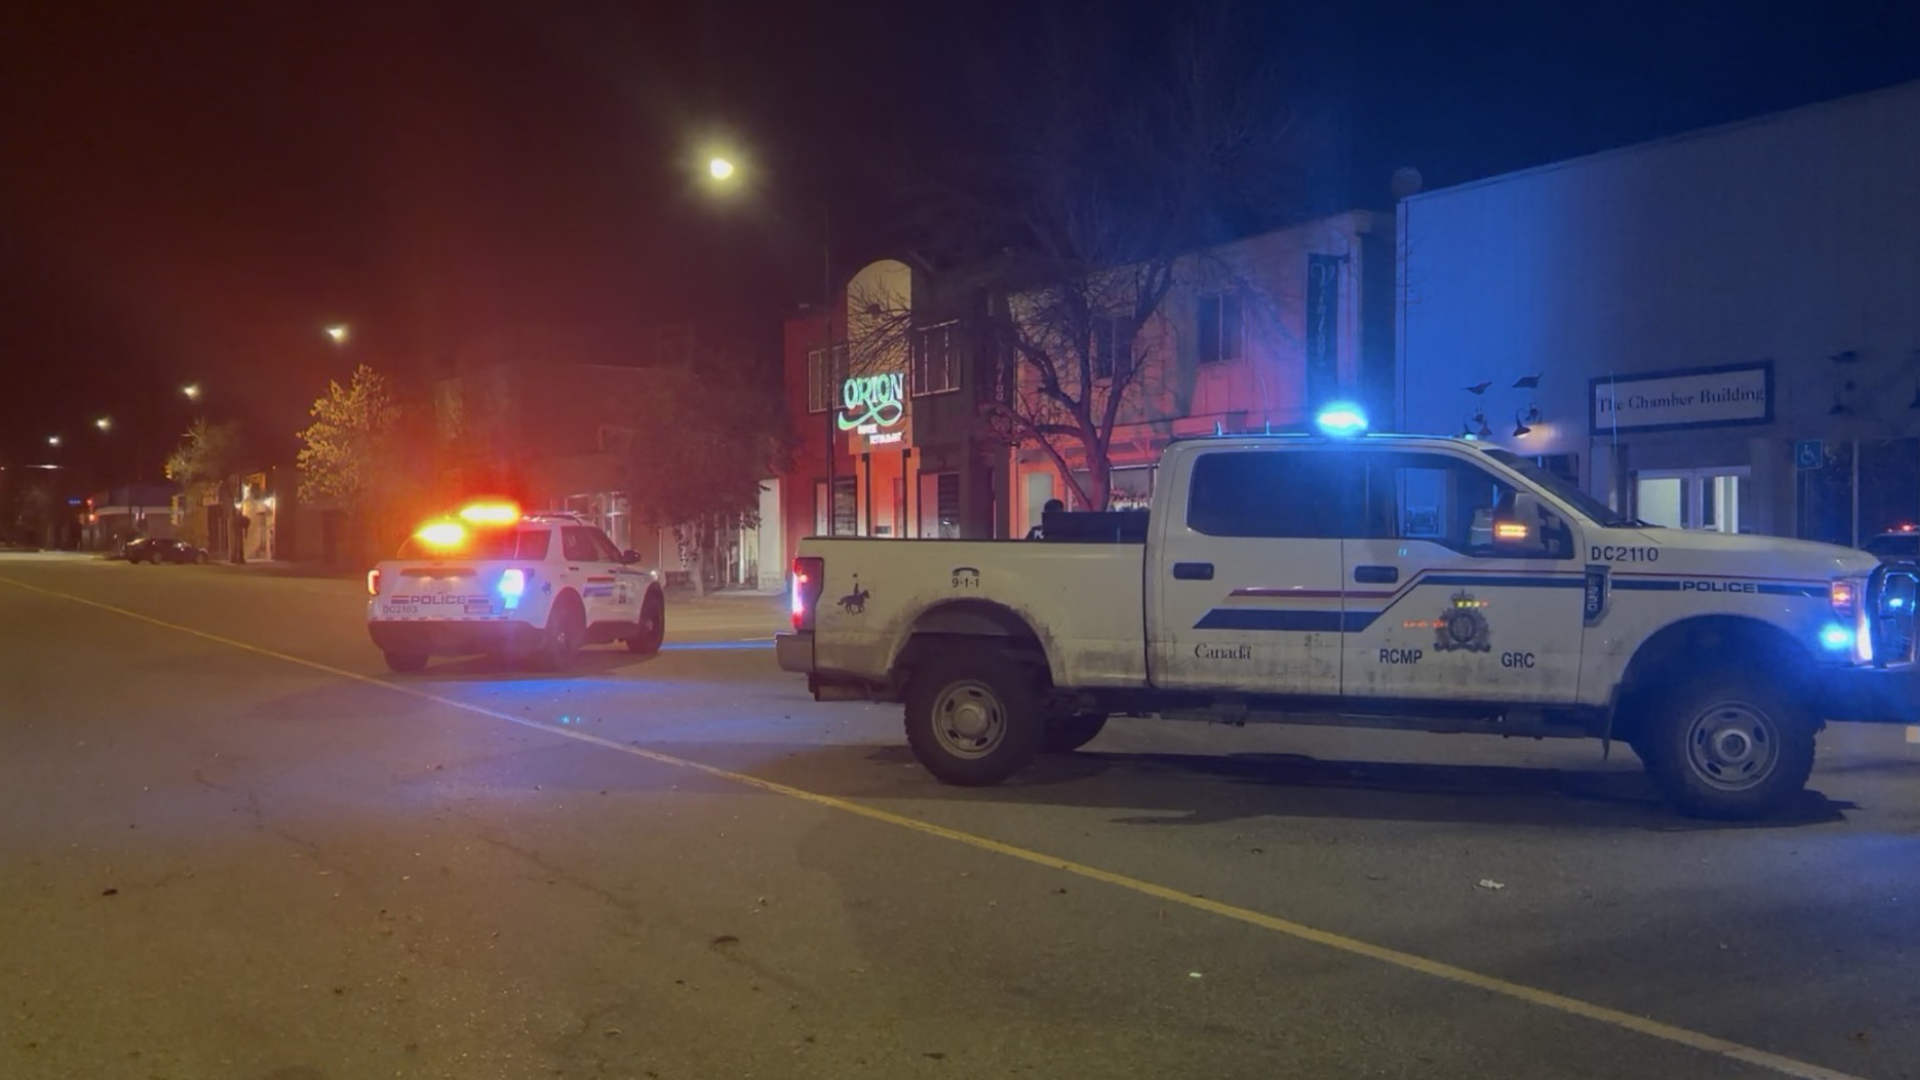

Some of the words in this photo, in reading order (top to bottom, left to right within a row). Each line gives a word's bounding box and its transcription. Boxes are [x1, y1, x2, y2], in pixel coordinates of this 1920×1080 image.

[839, 373, 904, 427] ORION
[1598, 396, 1623, 412] The
[1629, 391, 1694, 410] Chamber
[1700, 387, 1765, 404] Building
[1591, 546, 1659, 562] DC2110
[951, 577, 980, 589] 9-1-1
[1682, 581, 1757, 594] POLICE
[410, 595, 467, 605] POLICE
[1194, 642, 1252, 660] Canada
[1379, 648, 1423, 665] RCMP
[1501, 652, 1536, 669] GRC
